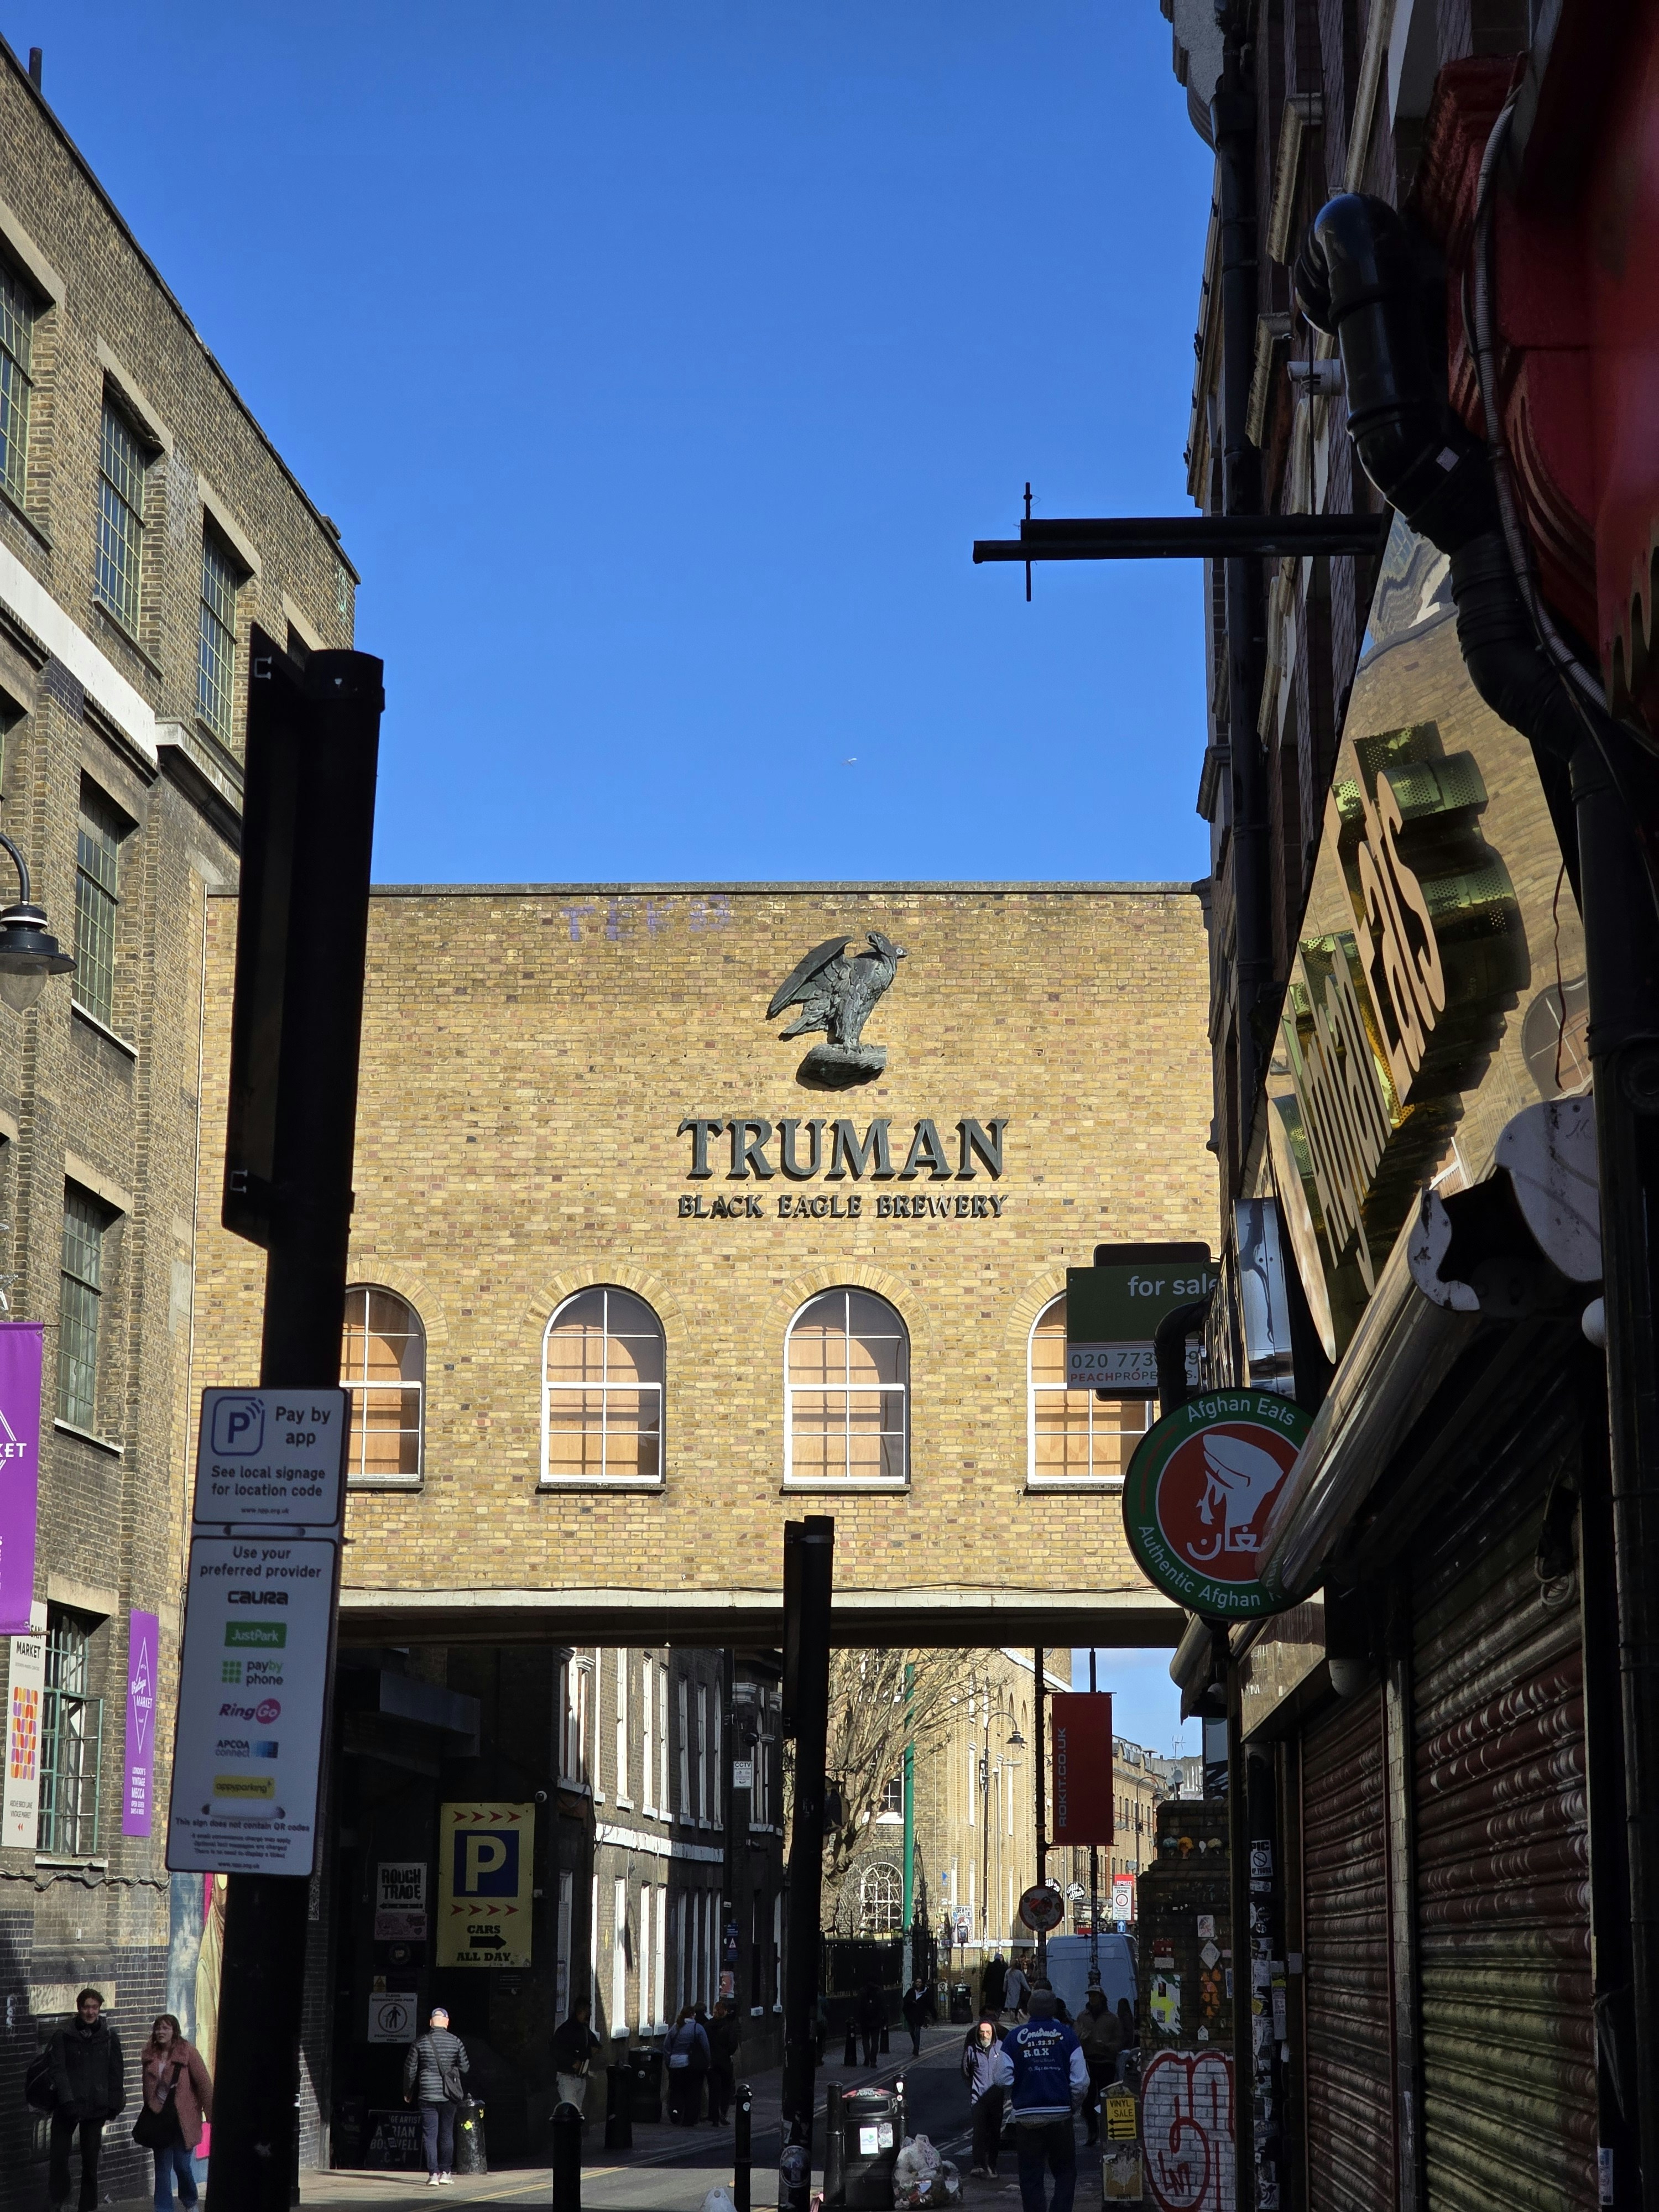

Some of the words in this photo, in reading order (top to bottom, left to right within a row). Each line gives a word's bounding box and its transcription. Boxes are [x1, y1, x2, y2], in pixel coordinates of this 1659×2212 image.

[680, 1118, 1008, 1181] TRUMAN
[678, 1194, 763, 1218] BLACK
[777, 1194, 863, 1218] EAGLE
[876, 1194, 1009, 1218] BREWERY
[1128, 1276, 1165, 1296] for
[1072, 1353, 1108, 1369] 020
[275, 1406, 305, 1425] Pay
[311, 1407, 331, 1425] by
[1188, 1396, 1250, 1422] Afghan
[1257, 1397, 1295, 1426] Eats
[227, 1411, 251, 1444] P
[285, 1432, 316, 1447] app
[211, 1466, 236, 1478] See
[240, 1466, 271, 1479] local
[275, 1467, 325, 1481] signage
[212, 1483, 230, 1495] for
[235, 1484, 287, 1496] location
[291, 1485, 322, 1496] code
[233, 1546, 257, 1558] Use
[262, 1549, 291, 1561] your
[200, 1563, 262, 1577] preferred
[265, 1565, 322, 1579] provider
[1138, 1526, 1195, 1593] Authentic
[1198, 1585, 1261, 1609] Afghan
[231, 1630, 279, 1641] JustPark
[16, 1641, 41, 1658] MARKET
[246, 1673, 284, 1686] phone
[136, 1695, 153, 1709] MARKET
[219, 1703, 278, 1720] RingGo
[217, 1740, 249, 1749] APCOA
[215, 1749, 250, 1757] connect
[1058, 1727, 1067, 1828] ROKIT.CO.UK
[132, 1787, 145, 1799] MECCA
[175, 1817, 190, 1827] This
[192, 1819, 208, 1828] sign
[465, 1835, 507, 1892] P
[382, 1869, 421, 1884] ROUGH
[382, 1884, 421, 1900] TRADE
[1067, 1882, 1079, 1893] All
[1069, 1889, 1084, 1901] Star
[467, 1924, 501, 1934] CARS
[456, 1952, 480, 1961] ALL
[484, 1952, 511, 1961] DAY
